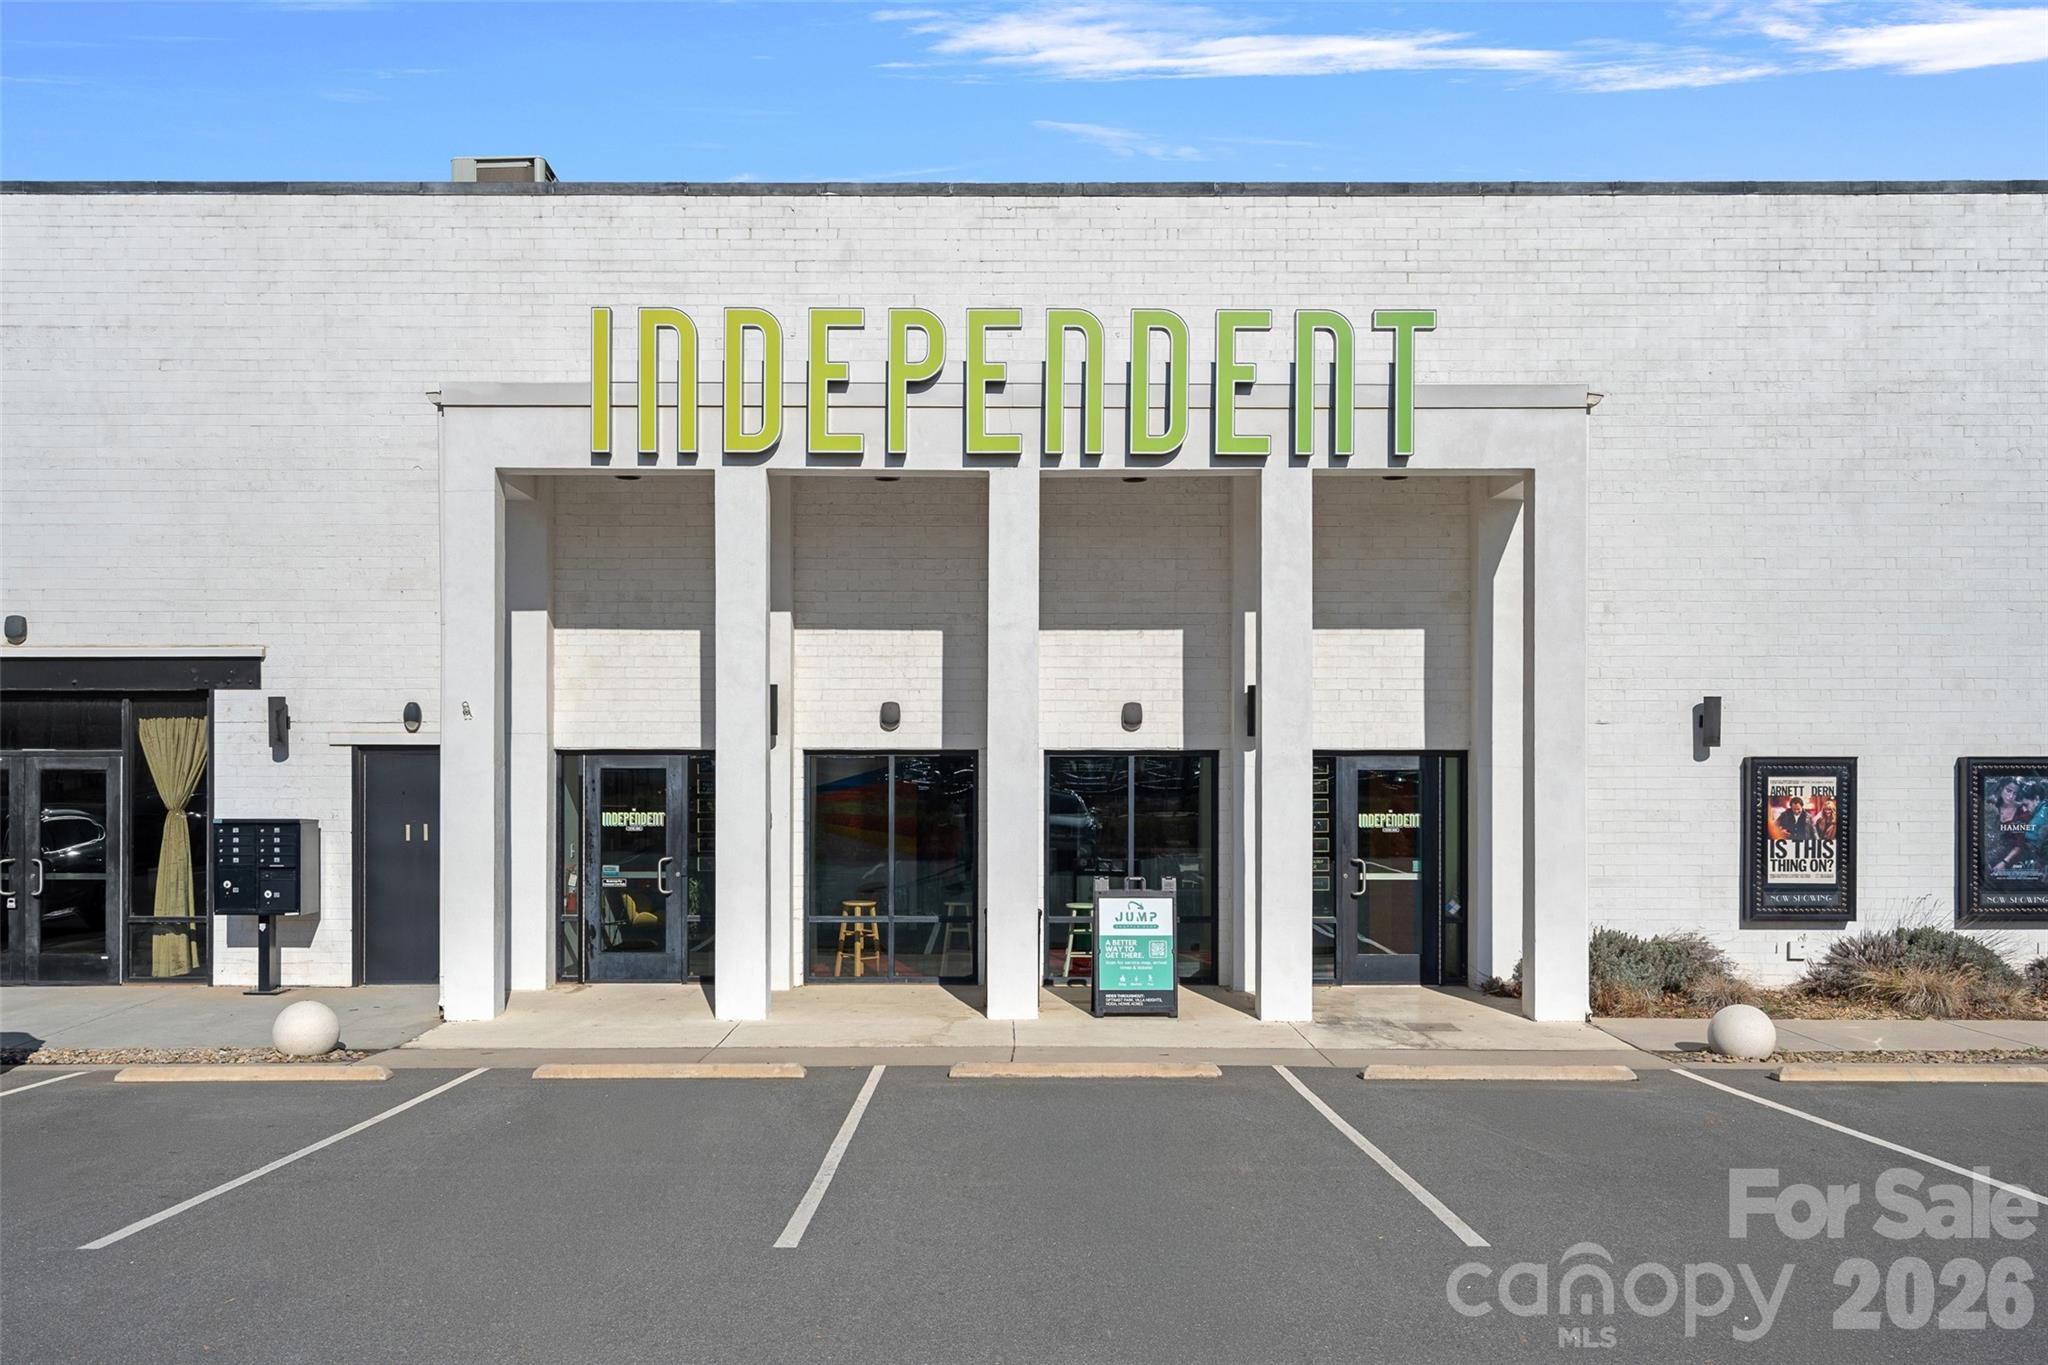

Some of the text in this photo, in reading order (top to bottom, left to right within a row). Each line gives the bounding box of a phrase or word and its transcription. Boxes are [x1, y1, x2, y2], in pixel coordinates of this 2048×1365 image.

[590, 306, 1438, 457] INDEPENDENT
[1770, 786, 1835, 797] ARNETT DERN
[602, 811, 666, 827] INDEPENDENT
[1358, 813, 1421, 828] INDEPENDENT
[2000, 824, 2036, 832] HAMNET
[1770, 839, 1834, 859] IS THIS
[1770, 859, 1834, 872] THING ON?
[1770, 894, 1833, 903] NOW SHOWING
[1985, 896, 2006, 904] NOW
[1115, 912, 1158, 922] JUMP
